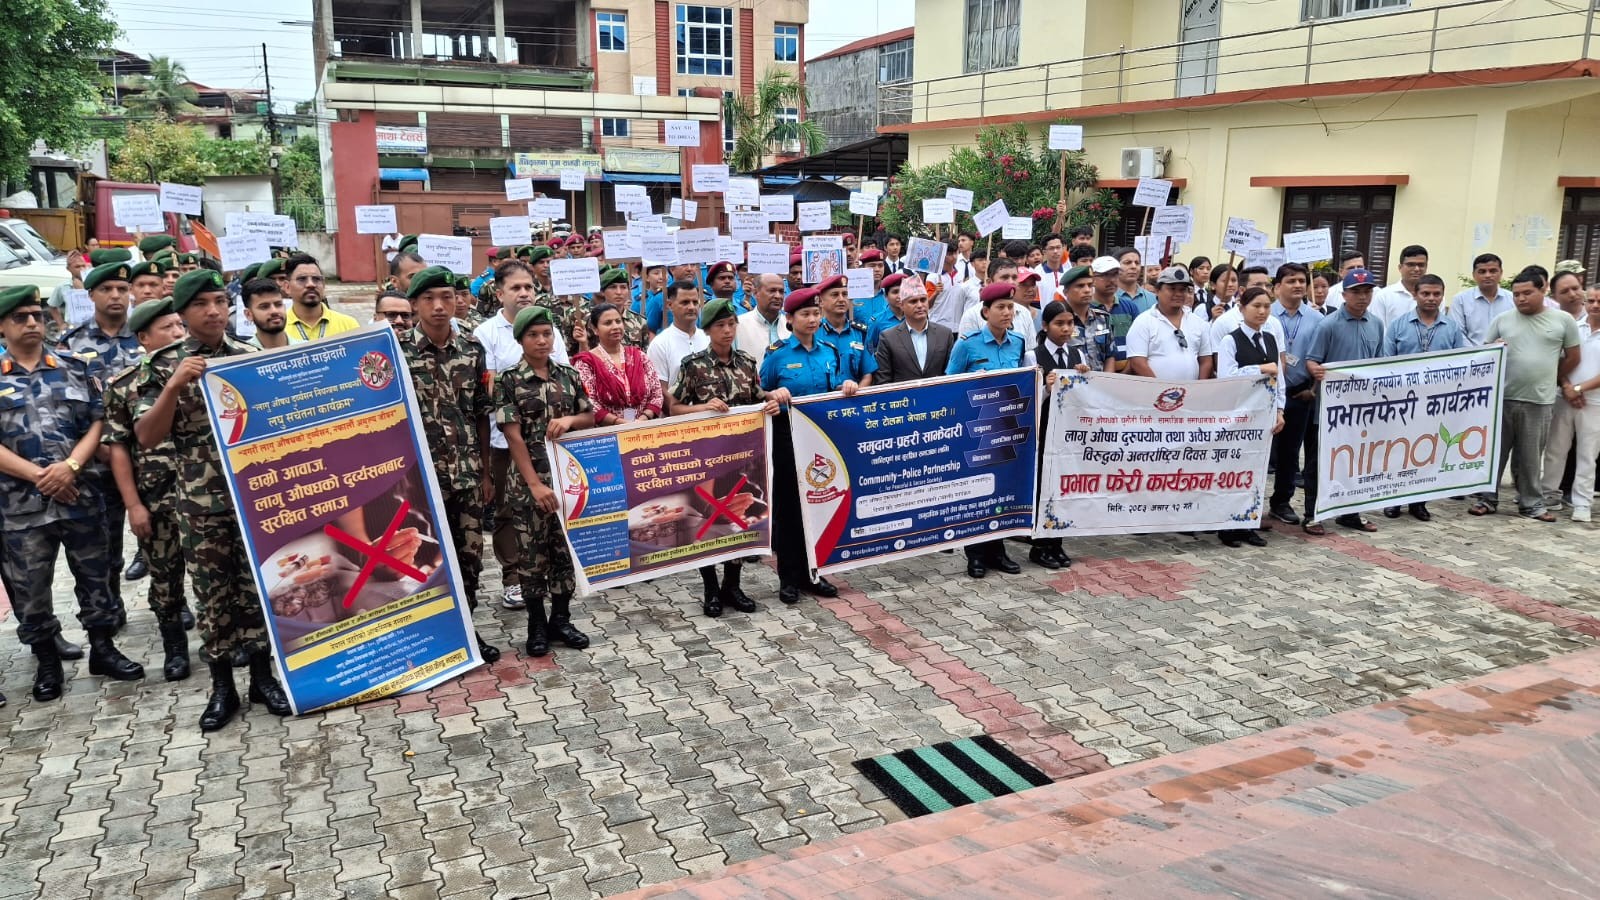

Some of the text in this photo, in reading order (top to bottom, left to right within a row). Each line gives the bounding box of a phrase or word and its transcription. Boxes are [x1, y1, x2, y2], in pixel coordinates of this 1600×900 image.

[256, 353, 310, 379] समुदाय-प्रहरी
[311, 344, 347, 364] साझेदारी
[1405, 371, 1420, 387] तथा
[826, 409, 838, 420] हर
[841, 406, 859, 417] प्रहर,
[879, 402, 887, 410] र
[865, 420, 879, 429] टोल
[882, 415, 904, 427] टोलमा
[907, 412, 926, 423] नेपाल
[930, 406, 947, 420] प्रहरी
[1326, 382, 1493, 433] प्रभातफेरी कार्यक्रम
[267, 416, 287, 430] लघु
[287, 407, 316, 421] सचेतना
[857, 430, 920, 455] समुदाय-प्रहरी
[1064, 429, 1087, 446] लागु
[1090, 426, 1118, 443] औषध
[1165, 429, 1185, 444] तथा
[1188, 425, 1211, 442] अवैध
[1214, 425, 1264, 442] ओसारपसार
[260, 441, 276, 453] लागु
[1209, 449, 1229, 464] जुन
[1230, 448, 1242, 460] २६
[1329, 423, 1488, 481] nirnaya
[631, 452, 655, 466] हाम्रो
[633, 466, 657, 479] लागु
[659, 459, 701, 475] औषधको
[923, 460, 961, 476] Partnership
[1458, 459, 1485, 471] change
[248, 468, 279, 491] हाम्रो
[253, 456, 405, 512] लागु औषधको दुर्व्यसनबाट
[602, 484, 624, 493] DRUGS
[635, 471, 706, 492] सुरक्षित समाज
[1060, 467, 1254, 497] प्रभात फेरी कार्यक्रम-२०८३
[259, 495, 349, 535] सुरक्षित समाज
[1150, 503, 1169, 513] असार
